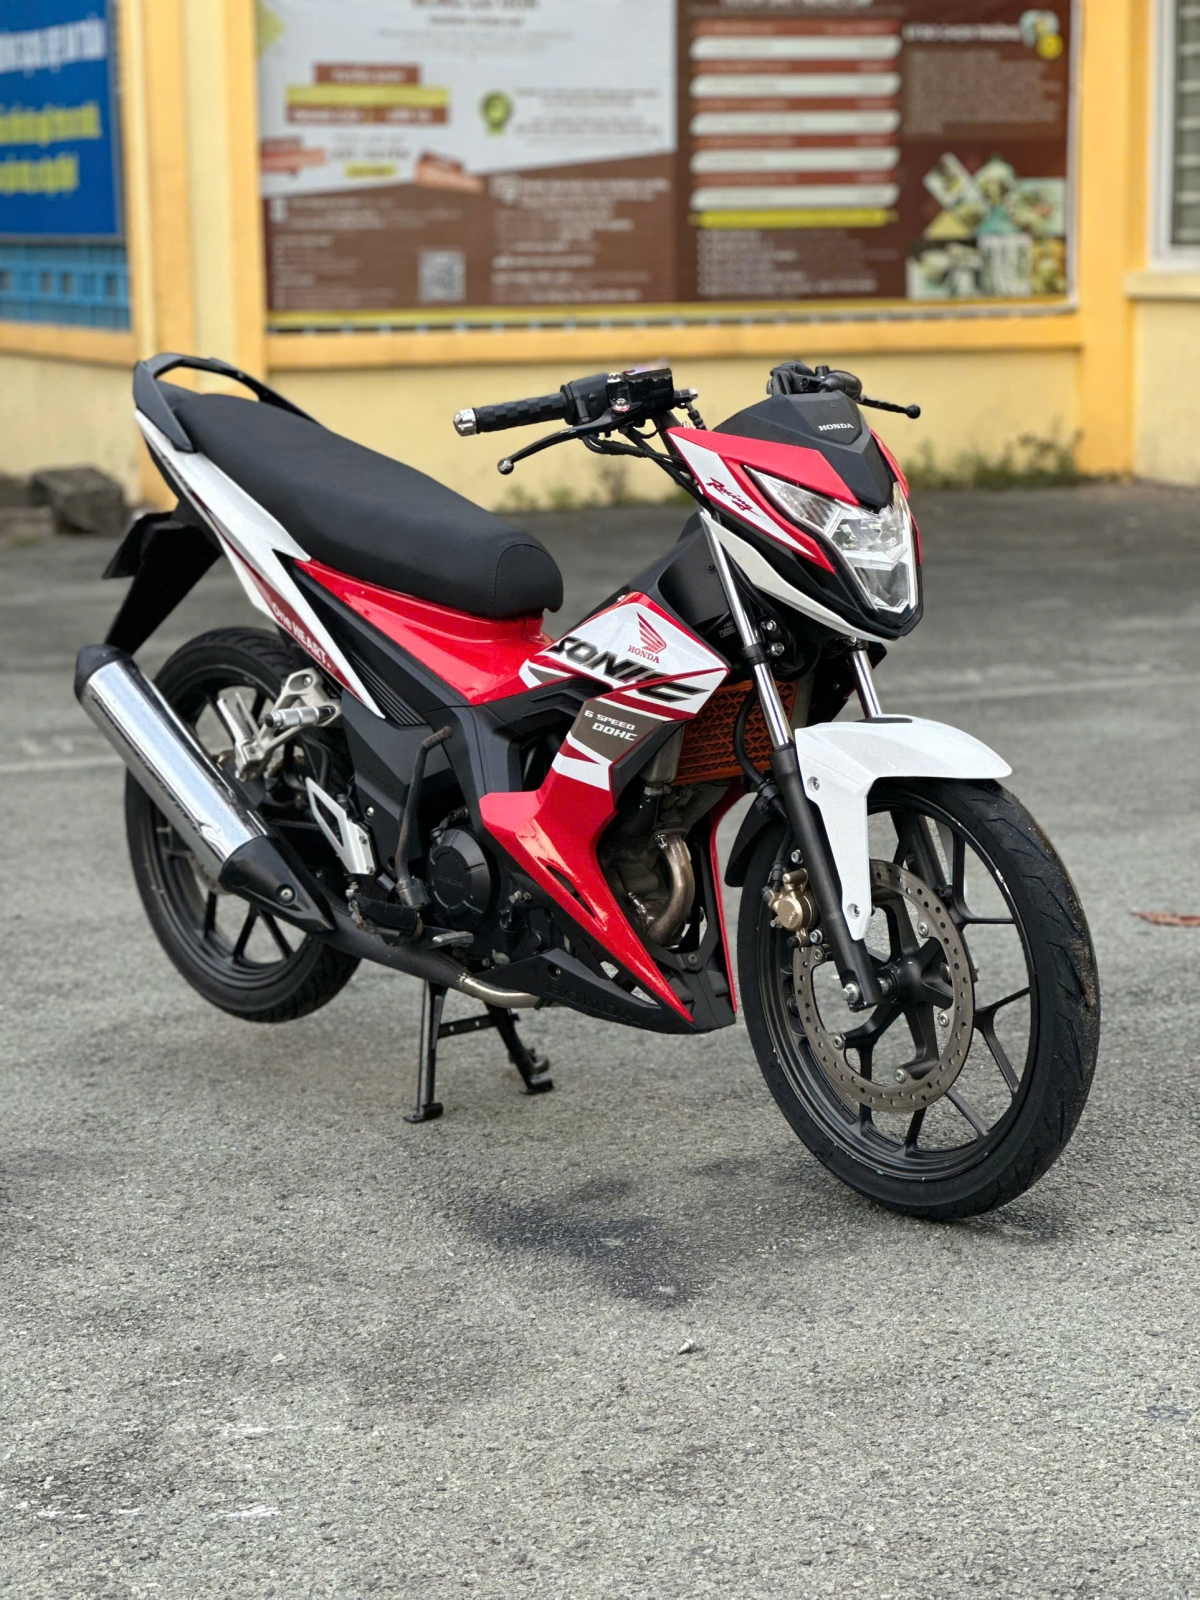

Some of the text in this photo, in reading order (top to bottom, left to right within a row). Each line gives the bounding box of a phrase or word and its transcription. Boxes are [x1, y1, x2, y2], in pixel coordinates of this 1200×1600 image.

[818, 422, 854, 431] HONDA
[706, 477, 762, 515] Racing
[271, 602, 292, 629] One
[627, 645, 659, 664] HONDA
[547, 636, 710, 702] SONIC
[584, 709, 636, 731] 6 SPEED
[592, 722, 638, 741] DOHC
